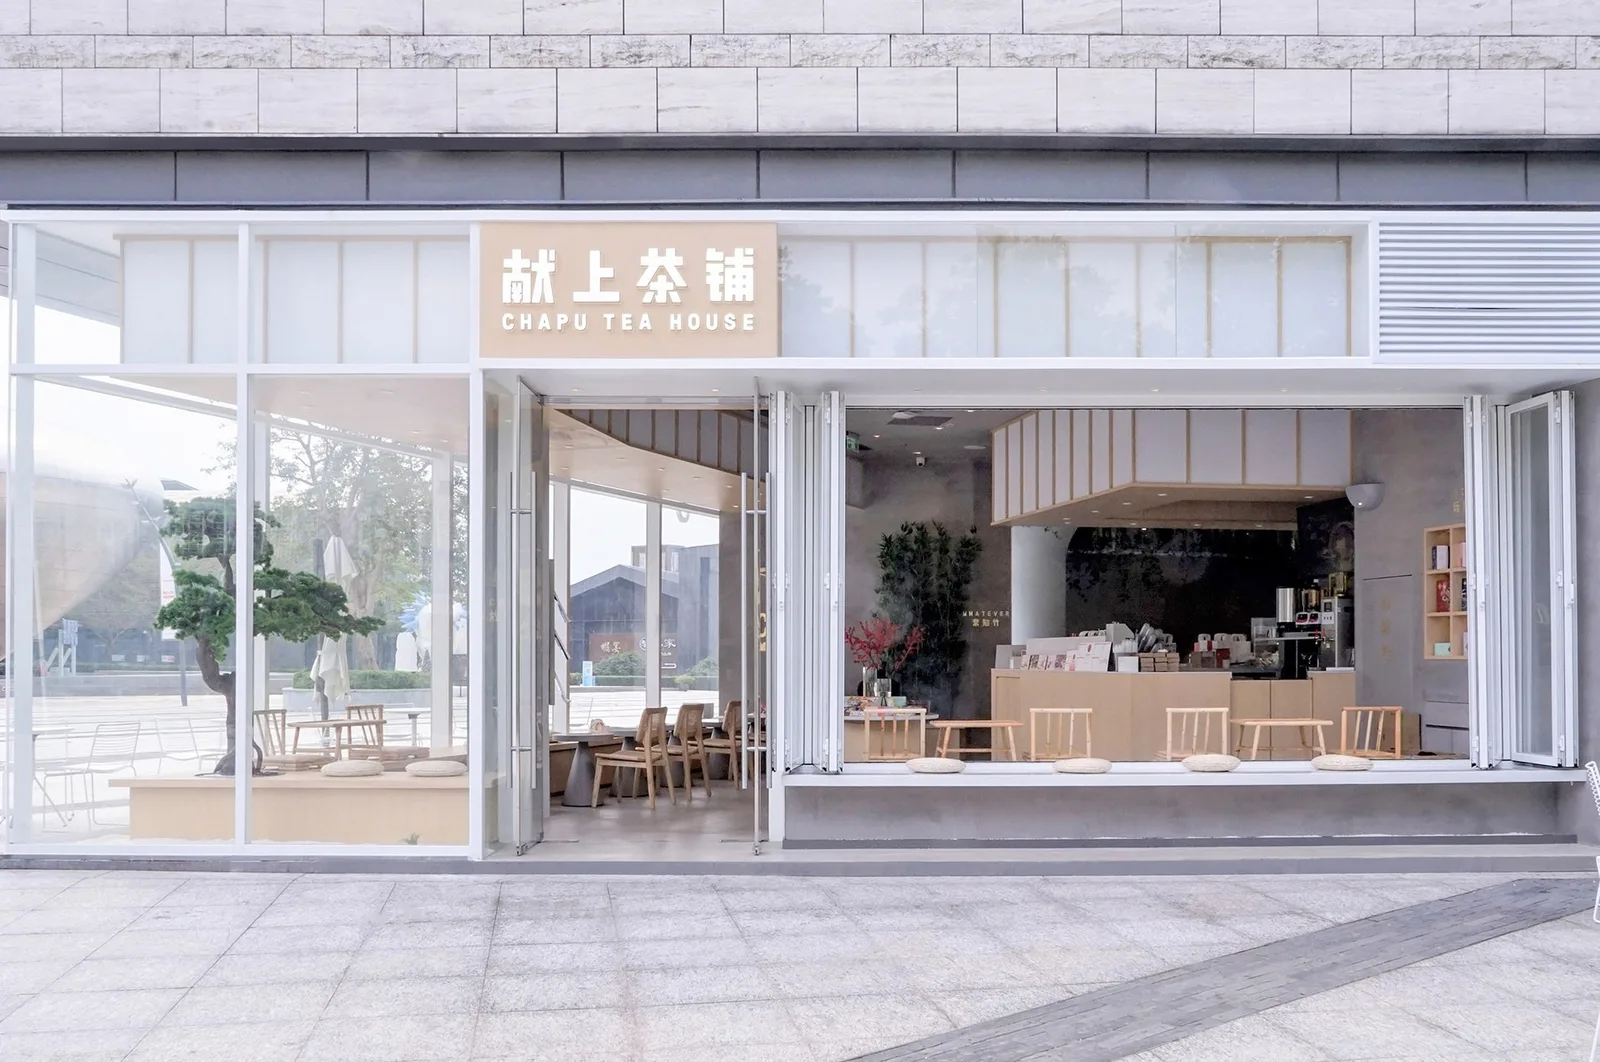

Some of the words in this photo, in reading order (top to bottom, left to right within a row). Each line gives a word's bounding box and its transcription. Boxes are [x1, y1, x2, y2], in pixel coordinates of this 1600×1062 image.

[502, 248, 755, 304] 献上茶铺
[502, 313, 588, 331] CHAPU
[603, 313, 652, 331] TEA
[669, 313, 755, 331] HOUSE
